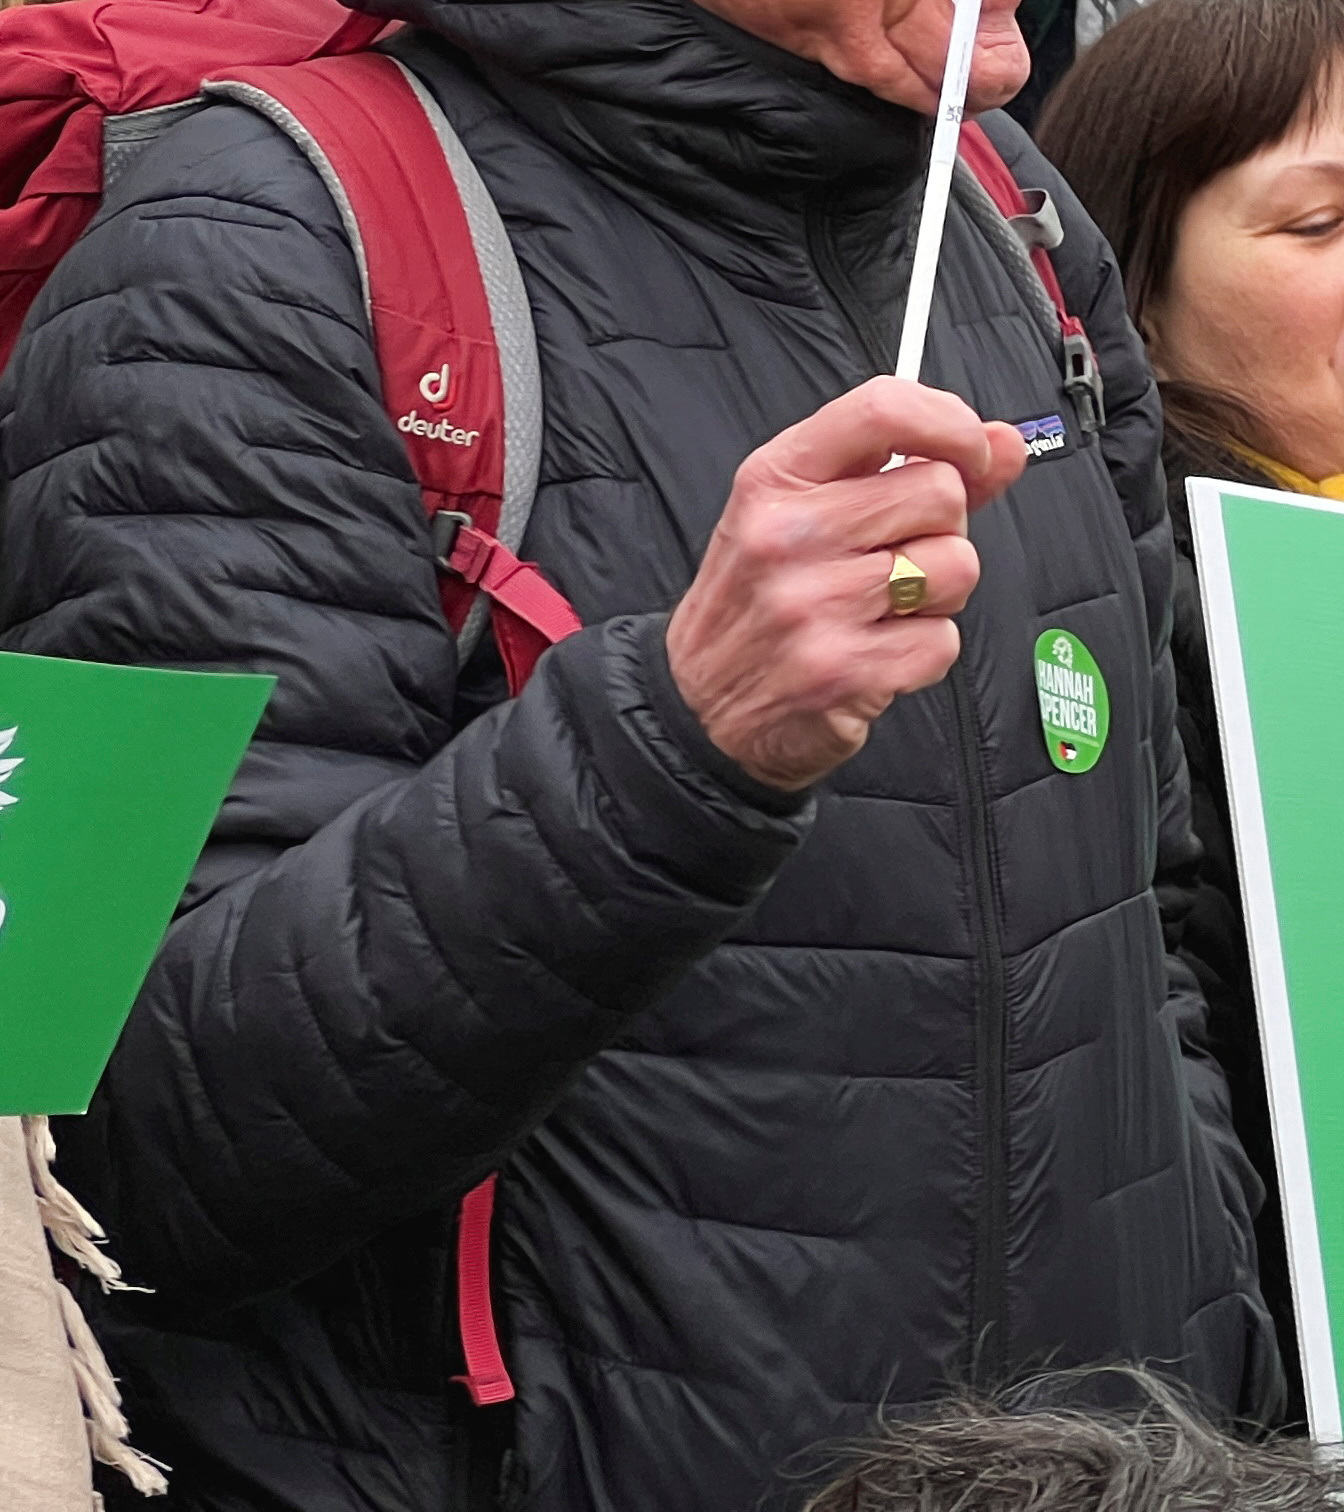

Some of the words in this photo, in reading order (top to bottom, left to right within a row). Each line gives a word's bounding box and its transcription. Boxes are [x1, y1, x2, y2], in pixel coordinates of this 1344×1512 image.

[397, 410, 480, 446] deuter
[1038, 659, 1094, 706] HANNAH
[1040, 689, 1097, 738] SPENCER
